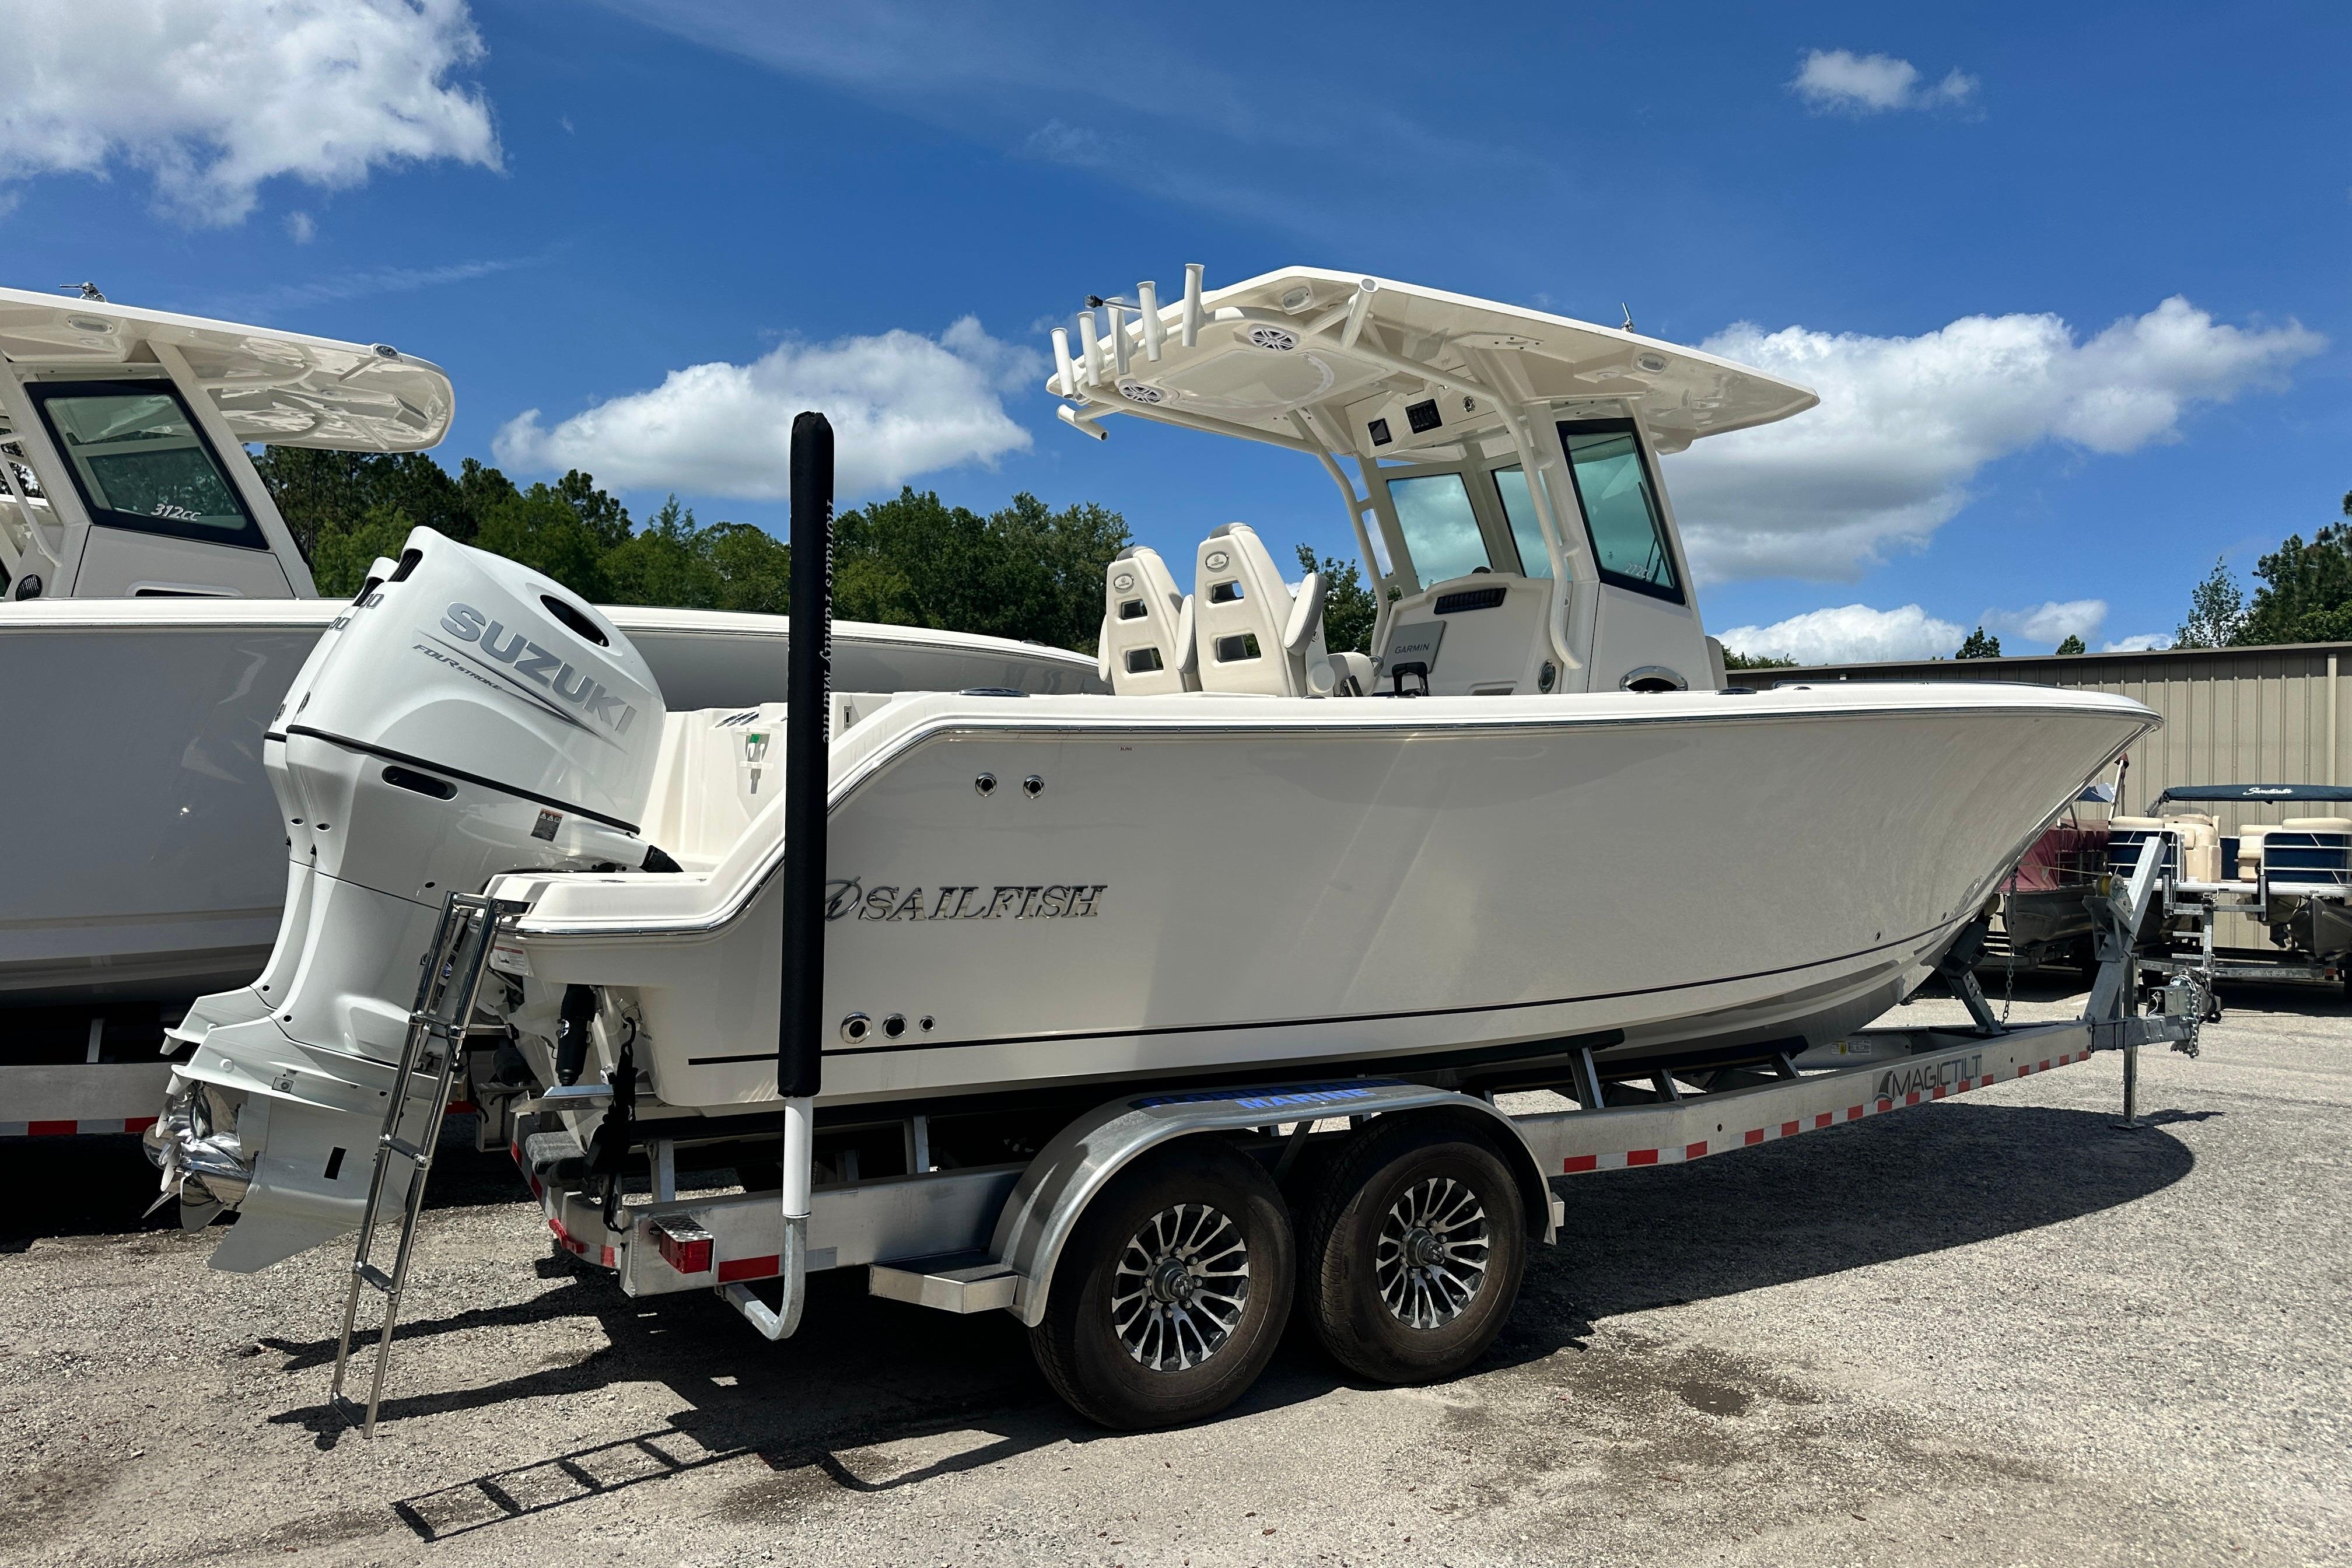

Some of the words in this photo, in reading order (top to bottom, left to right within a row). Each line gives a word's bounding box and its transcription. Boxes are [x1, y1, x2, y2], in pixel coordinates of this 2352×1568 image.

[1395, 643, 1430, 653] GARMIN
[440, 601, 637, 736] SUZUKI
[858, 885, 1108, 921] SAILFISH
[1235, 1088, 1377, 1109] MARINE
